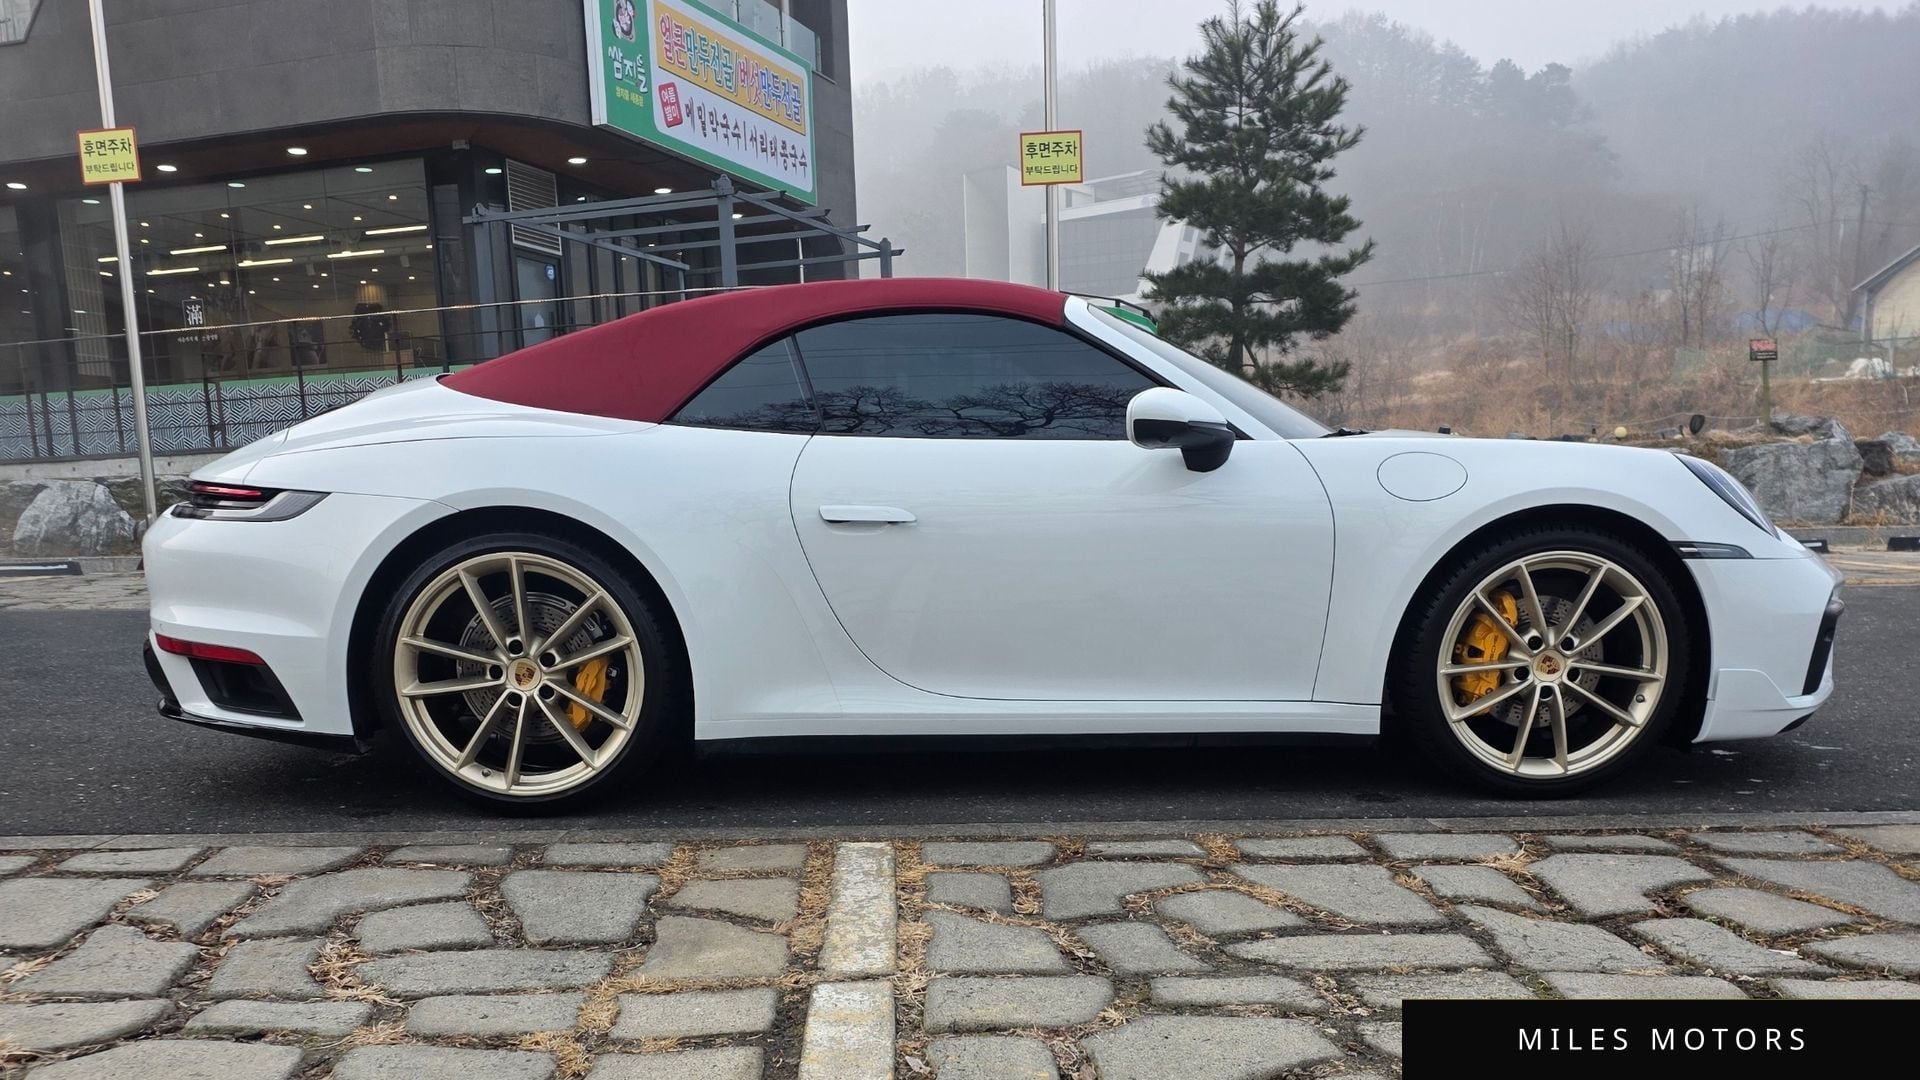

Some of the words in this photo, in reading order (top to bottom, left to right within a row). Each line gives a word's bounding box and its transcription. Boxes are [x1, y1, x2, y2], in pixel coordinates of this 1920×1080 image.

[659, 13, 734, 92] 얼큰만두전골
[739, 55, 802, 125] 버섯만두전골
[684, 96, 741, 150] 메밀막국수
[83, 137, 132, 157] 후면주차
[1025, 140, 1078, 159] 후면주차
[85, 161, 135, 174] 부탁드립니다
[1025, 164, 1078, 175] 부탁드립니다
